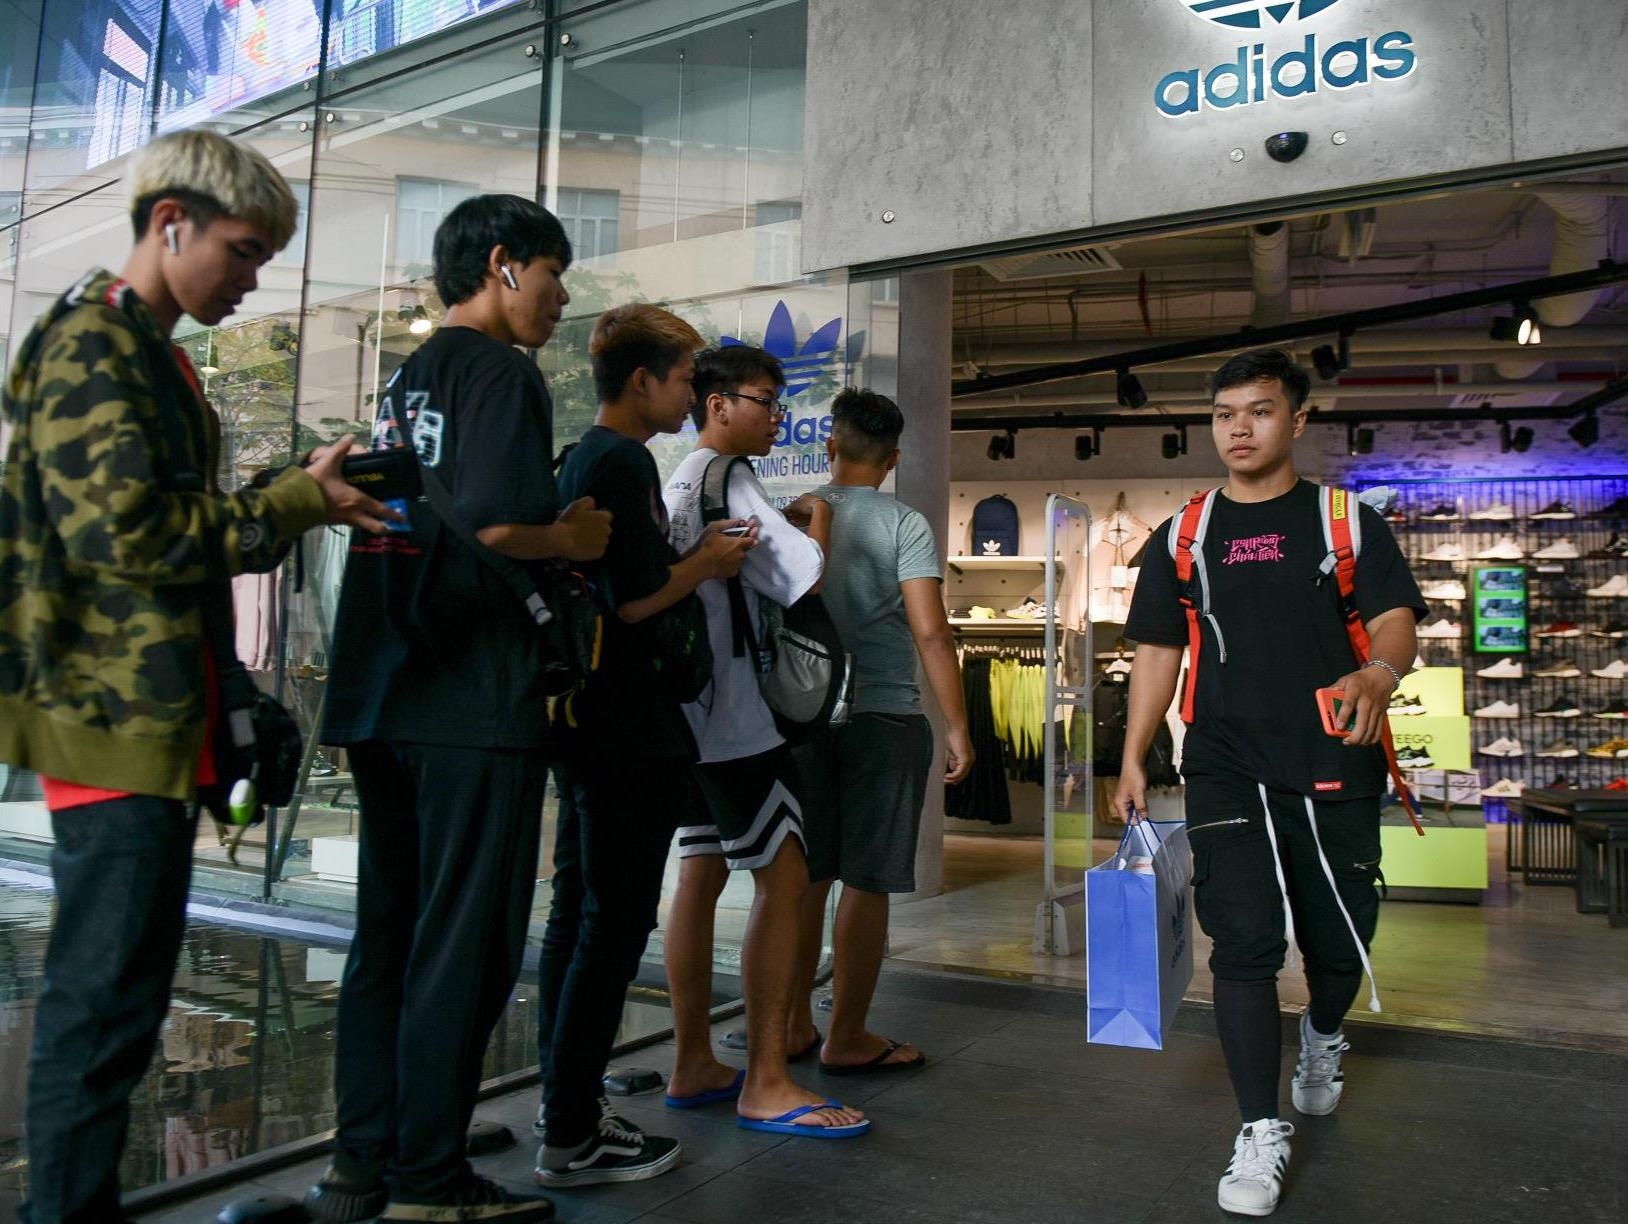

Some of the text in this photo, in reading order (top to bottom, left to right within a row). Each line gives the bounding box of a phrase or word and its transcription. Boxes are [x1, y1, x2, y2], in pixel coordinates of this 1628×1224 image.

[1154, 31, 1416, 117] adidas
[773, 411, 833, 447] das
[751, 453, 829, 478] NING HOUR
[1395, 734, 1433, 744] EEGO
